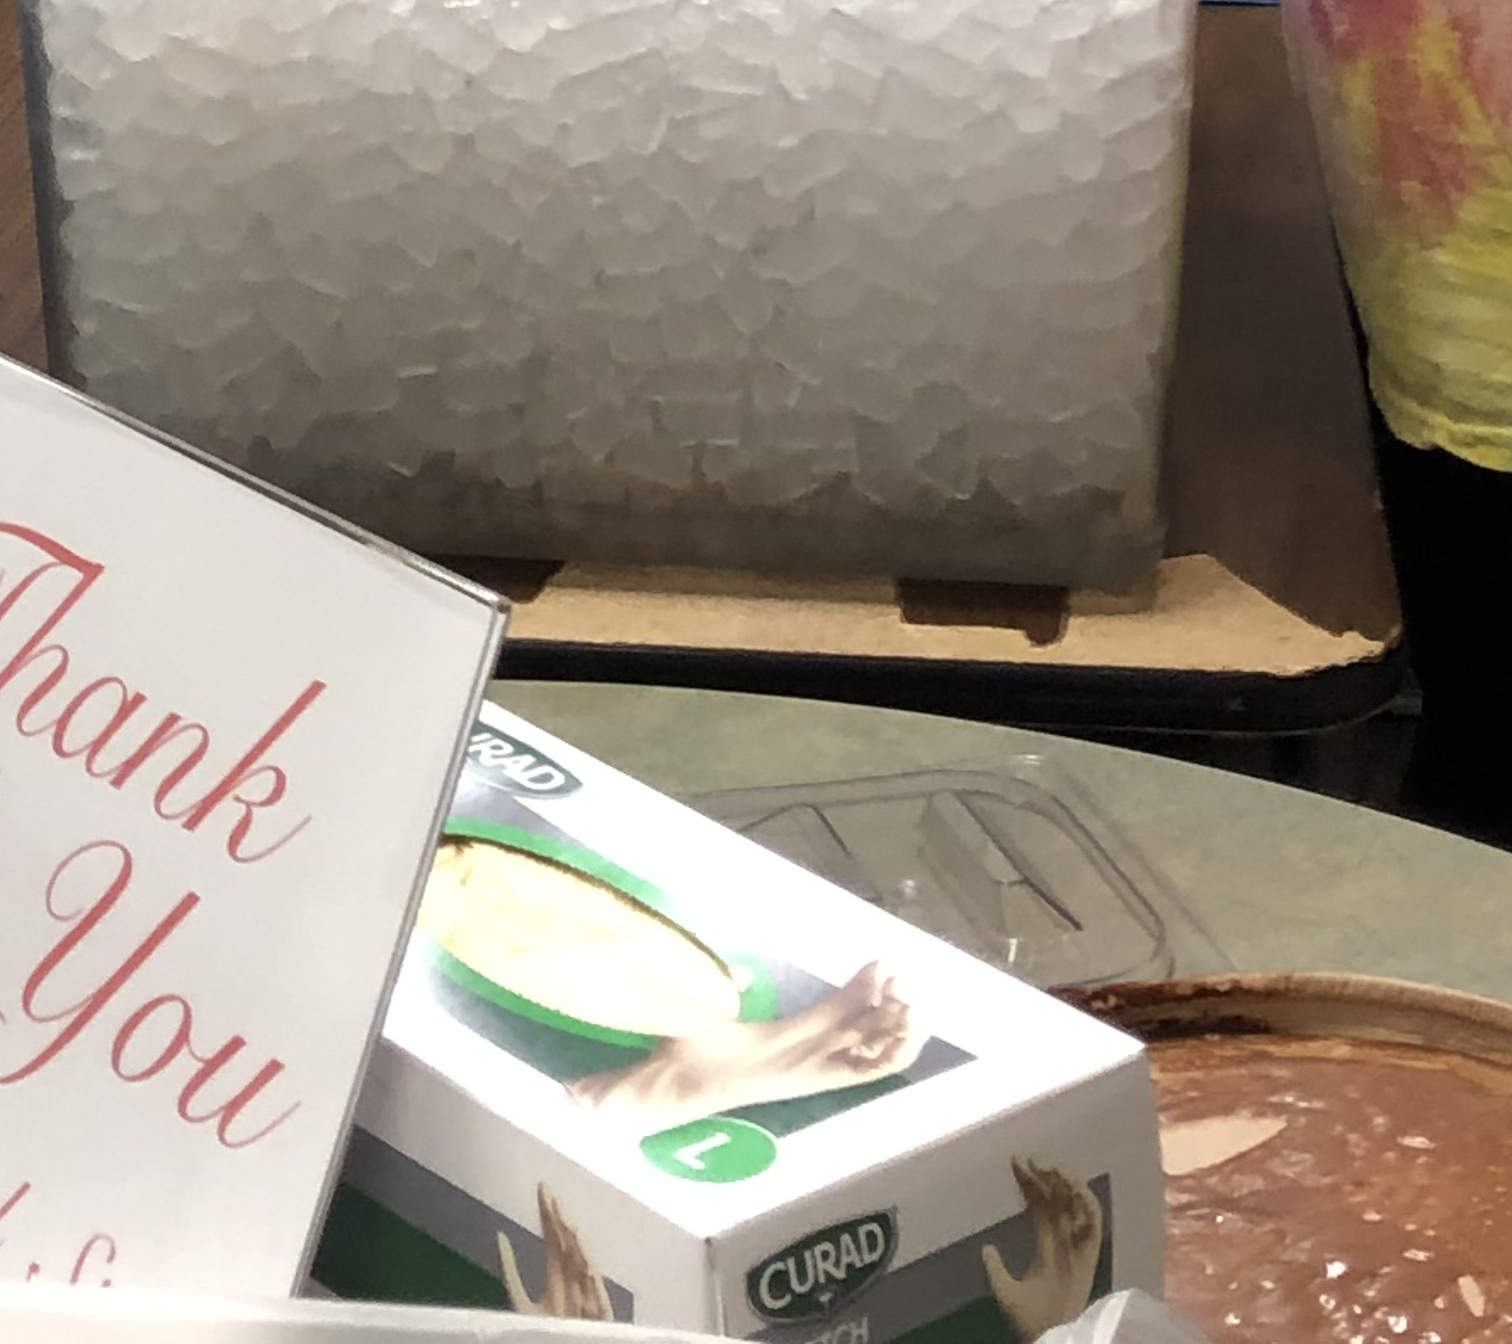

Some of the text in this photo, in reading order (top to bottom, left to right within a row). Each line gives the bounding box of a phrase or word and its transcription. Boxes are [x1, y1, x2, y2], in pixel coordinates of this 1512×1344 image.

[468, 731, 566, 791] RAD
[674, 1131, 732, 1171] L
[758, 1222, 886, 1310] CURAD
